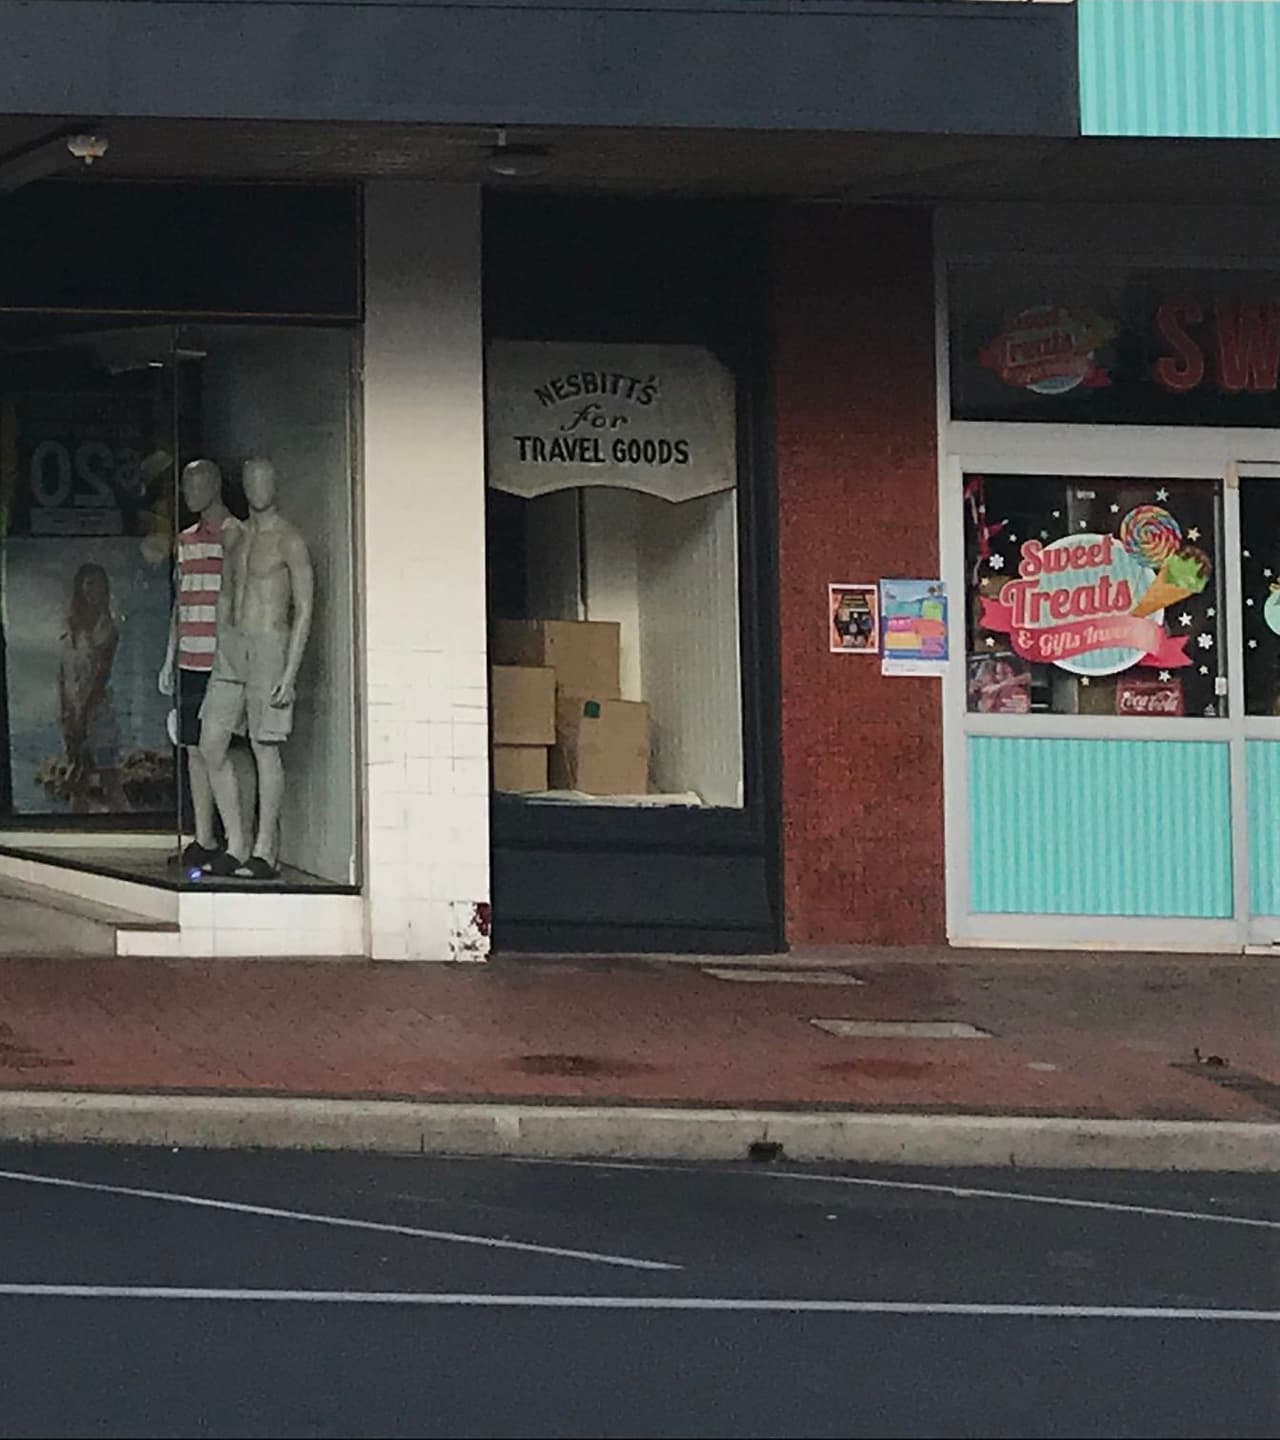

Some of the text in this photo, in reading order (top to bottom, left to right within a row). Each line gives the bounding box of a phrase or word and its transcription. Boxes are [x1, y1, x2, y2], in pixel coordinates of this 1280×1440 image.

[534, 371, 659, 407] NESBITT'S
[559, 403, 629, 432] for
[513, 435, 690, 465] TRAVEL GOODS
[1018, 534, 1115, 579] Sweet
[1000, 574, 1134, 629] Treats
[1017, 629, 1034, 649] &
[1040, 630, 1081, 657] Gifts
